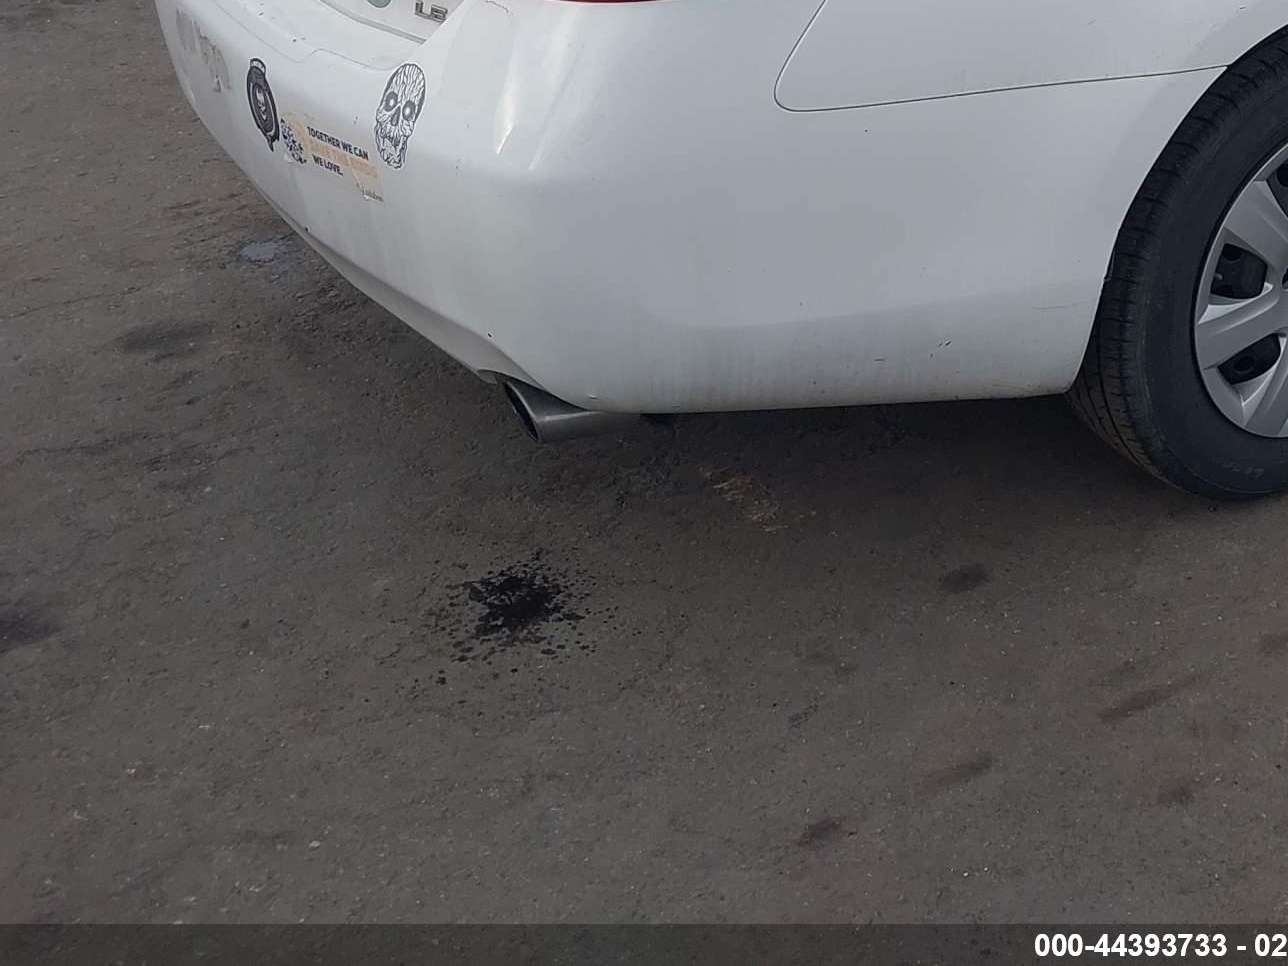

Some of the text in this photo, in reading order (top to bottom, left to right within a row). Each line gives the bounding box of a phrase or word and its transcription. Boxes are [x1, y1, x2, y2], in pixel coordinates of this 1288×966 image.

[414, 0, 448, 22] LE
[307, 126, 341, 149] TOGETHER
[341, 141, 354, 155] WE
[353, 146, 369, 161] CAN
[312, 154, 325, 167] WE
